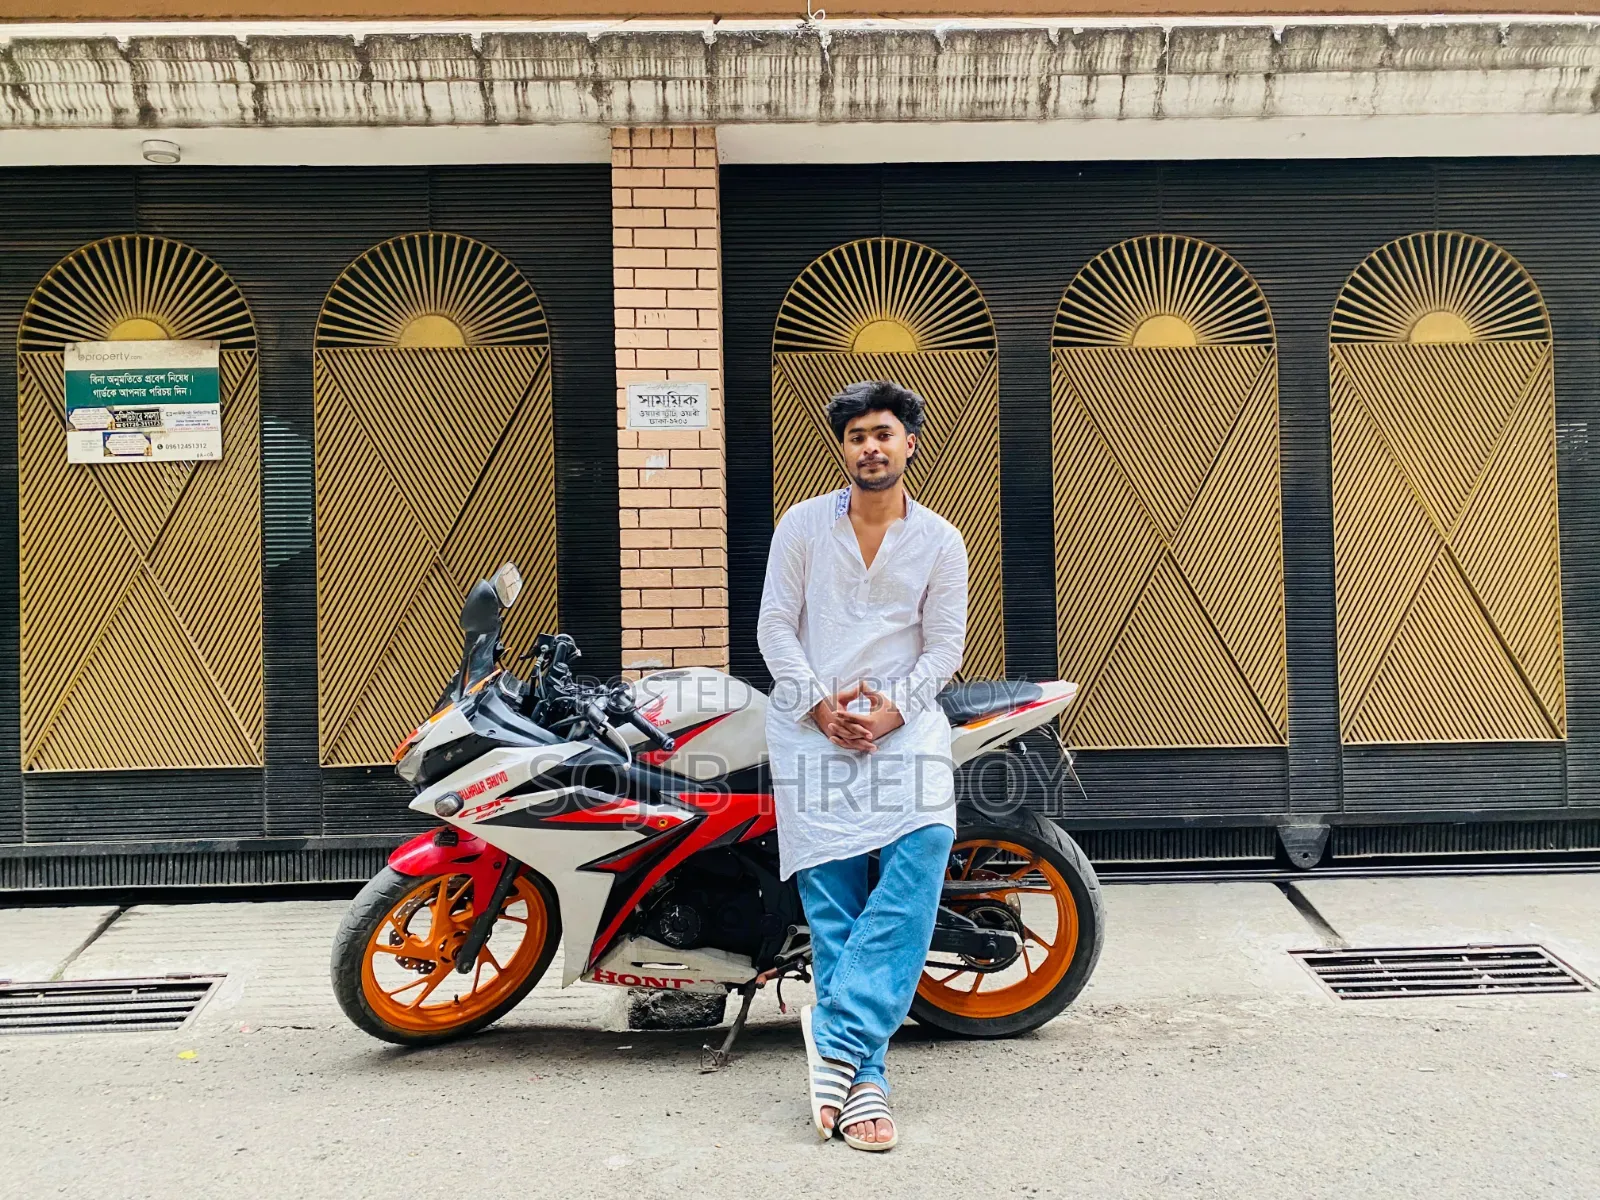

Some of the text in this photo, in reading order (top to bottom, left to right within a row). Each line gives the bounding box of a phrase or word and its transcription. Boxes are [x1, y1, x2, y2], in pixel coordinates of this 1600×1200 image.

[90, 373, 105, 384] বিনা
[107, 372, 143, 386] অনুমতিতে
[145, 374, 166, 383] প্রবেশ
[93, 386, 117, 398] গার্ডকে
[118, 388, 147, 397] আপনার
[149, 385, 172, 396] পরিচয়
[637, 391, 699, 408] সাময়িক
